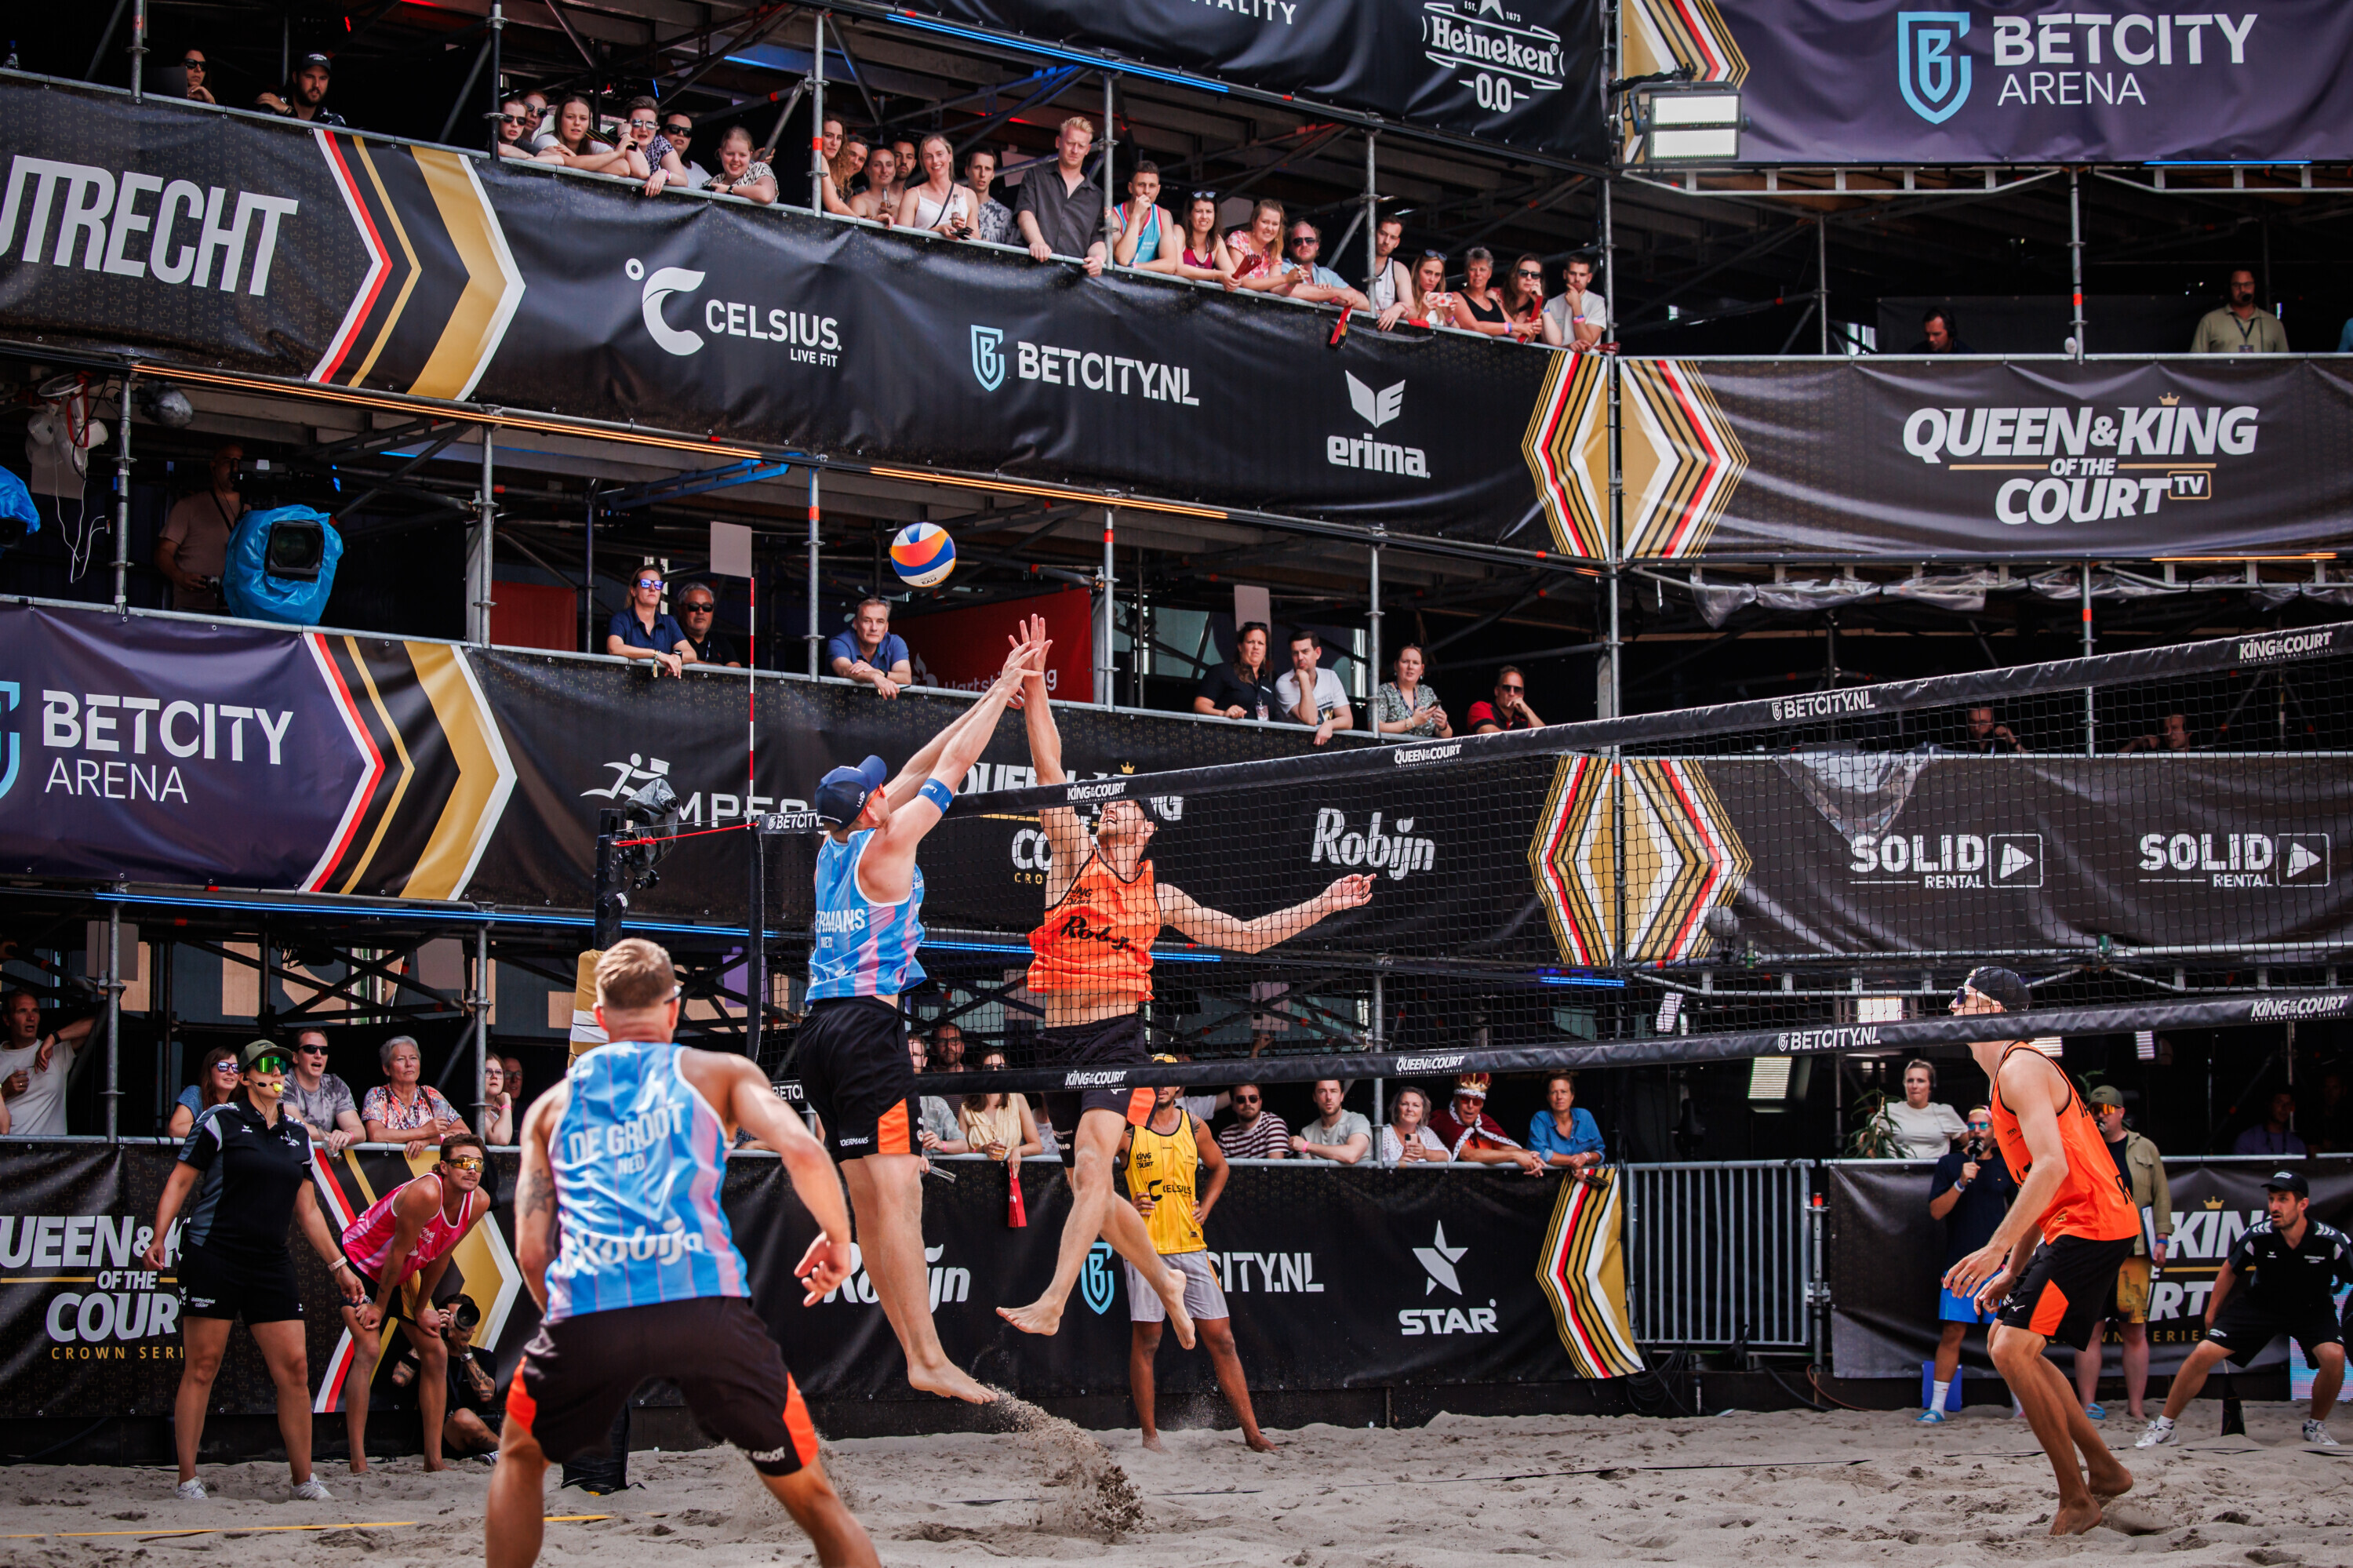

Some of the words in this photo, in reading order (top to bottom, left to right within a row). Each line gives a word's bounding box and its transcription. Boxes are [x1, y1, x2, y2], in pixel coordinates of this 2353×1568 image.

[1191, 0, 1297, 25] ALITY
[1464, 1, 1477, 12] EST.
[1505, 11, 1522, 22] 1873
[1431, 15, 1555, 75] Heineken
[1993, 13, 2258, 66] BETCITY
[1475, 72, 1512, 113] 0.0
[1997, 71, 2147, 106] ARENA
[790, 347, 816, 364] LIVE
[820, 352, 838, 367] FIT
[1017, 340, 1199, 406] BETCITY.NL
[1327, 432, 1426, 478] erima
[2050, 458, 2078, 475] OF
[2078, 457, 2116, 475] THE
[1995, 477, 2173, 525] COURT
[2173, 475, 2205, 494] TV
[2239, 639, 2276, 659] KING
[2283, 631, 2333, 653] COURT
[1784, 690, 1875, 719] BETCITY.NL
[42, 689, 294, 766] BETCITY
[1395, 748, 1426, 765] QUEEN
[1430, 744, 1462, 760] COURT
[45, 757, 188, 803] ARENA
[1067, 785, 1091, 801] KING
[1095, 782, 1127, 798] COURT
[1311, 807, 1435, 881] Robijn
[1849, 834, 1985, 872] SOLID
[2138, 833, 2273, 871] SOLID
[1014, 871, 1047, 885] CRO
[1924, 874, 1985, 889] RENTAL
[2213, 873, 2274, 887] RENTAL
[815, 908, 866, 934] ERMANS
[2250, 999, 2289, 1017] KING
[2297, 995, 2348, 1015] COURT
[1790, 1026, 1881, 1050] BETCITY.NL
[1396, 1057, 1428, 1072] QUEEN
[1432, 1055, 1465, 1070] COURT
[1064, 1072, 1090, 1086] KING
[1094, 1071, 1127, 1085] COURT
[568, 1126, 604, 1166] DE
[606, 1102, 686, 1156] GROOT
[617, 1153, 646, 1175] NED
[97, 1271, 122, 1290] OF
[123, 1271, 158, 1290] THE
[45, 1292, 179, 1343] COUR
[1398, 1308, 1499, 1335] STAR
[51, 1346, 125, 1360] CROWN
[139, 1346, 184, 1359] SERI
